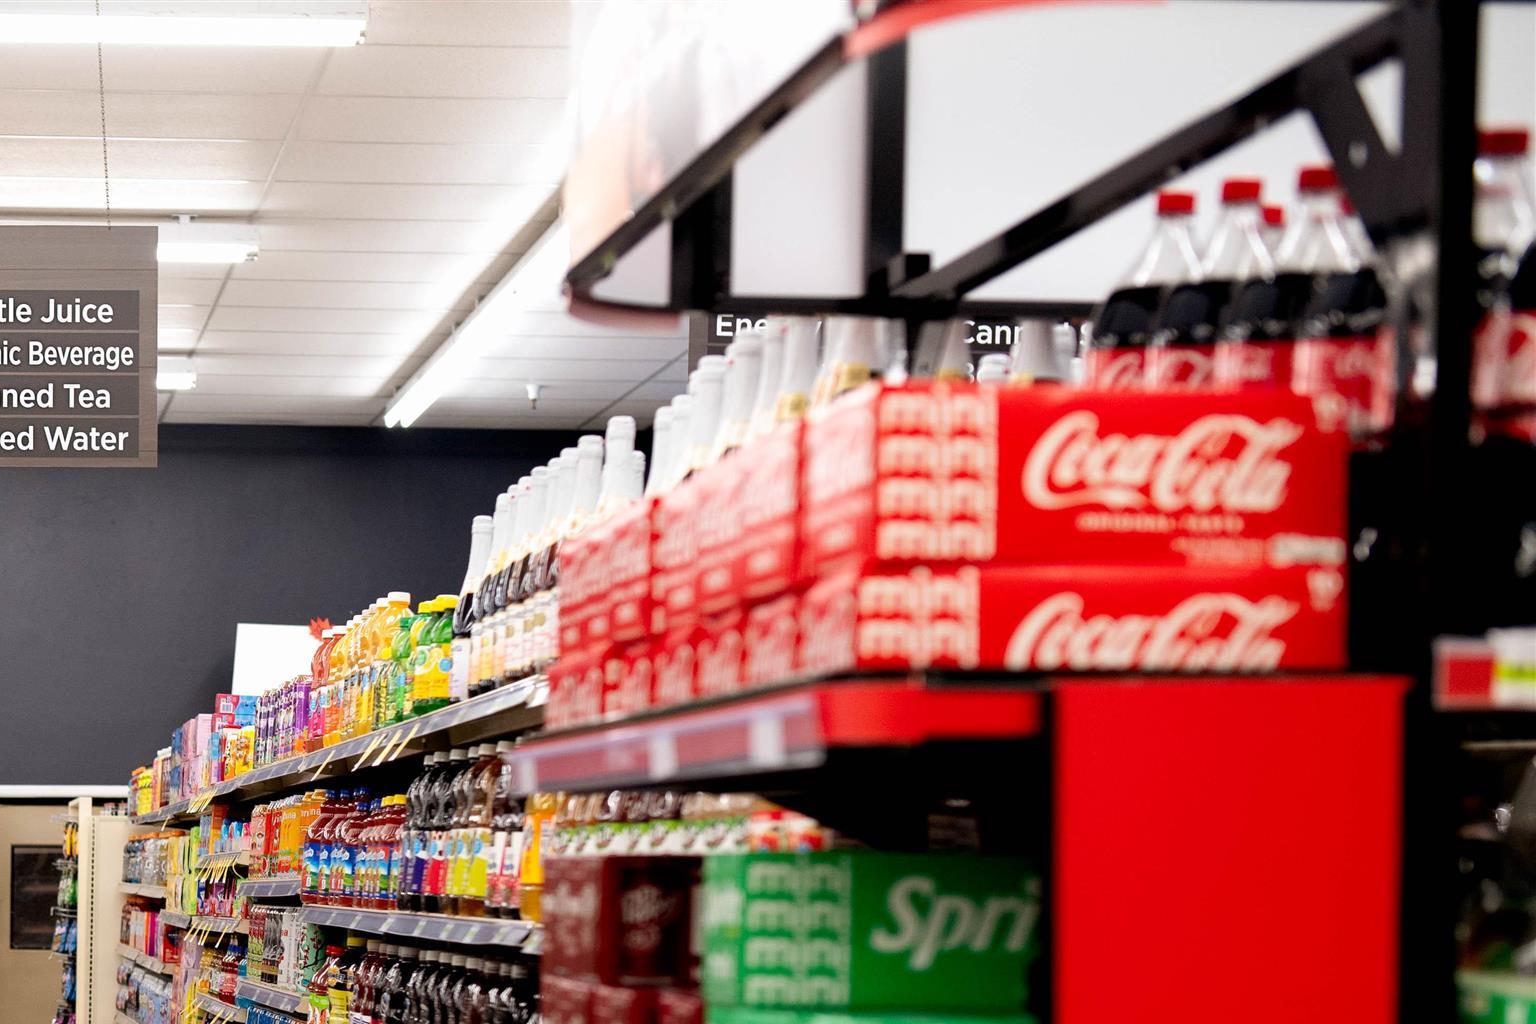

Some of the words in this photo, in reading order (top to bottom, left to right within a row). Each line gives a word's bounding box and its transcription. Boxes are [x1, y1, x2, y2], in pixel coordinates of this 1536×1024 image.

[40, 297, 114, 324] Juice
[28, 340, 134, 371] Beverage
[63, 383, 111, 409] Tea
[879, 386, 999, 435] mini
[43, 426, 129, 451] Water
[878, 432, 998, 477] mini
[876, 475, 998, 519] mini
[875, 517, 997, 561] mini
[859, 567, 981, 619] mini
[747, 856, 852, 900] mini
[746, 897, 851, 938] mini
[871, 876, 1041, 971] Spri
[745, 936, 850, 975] mini
